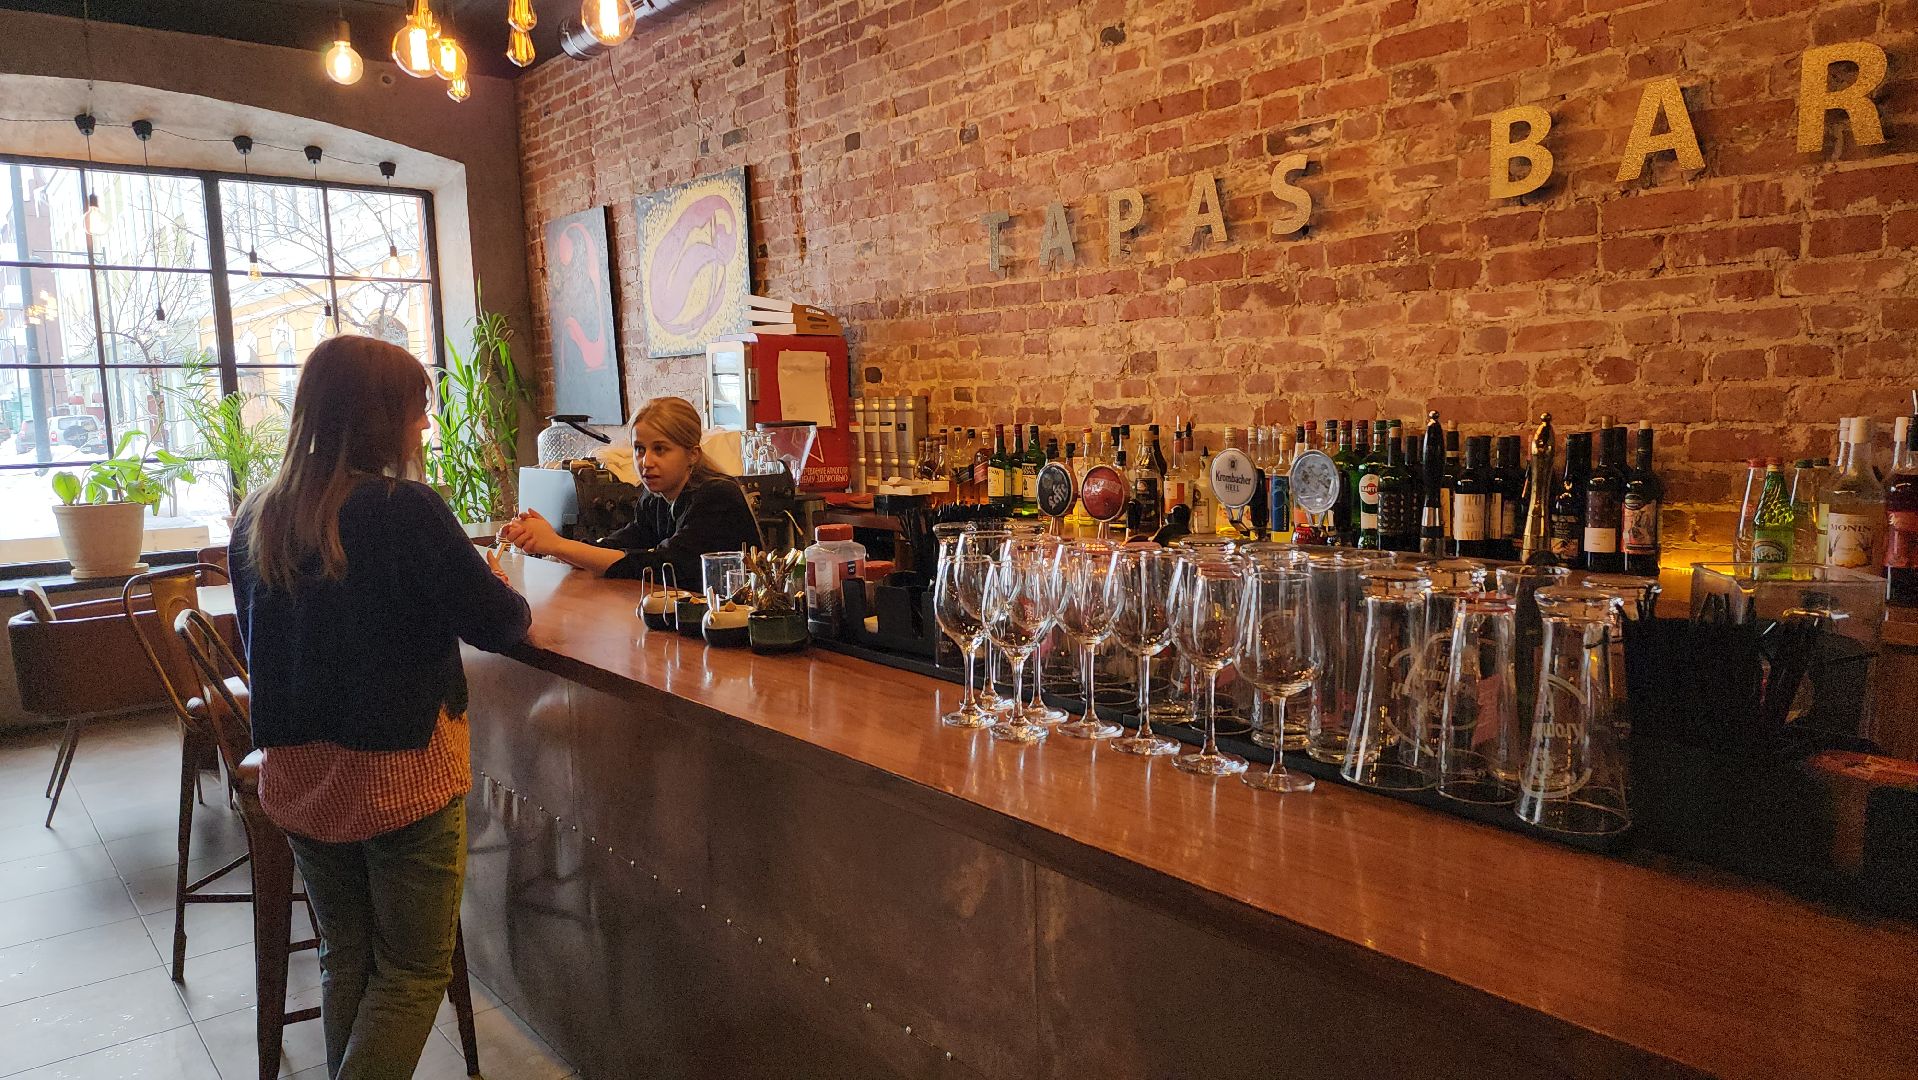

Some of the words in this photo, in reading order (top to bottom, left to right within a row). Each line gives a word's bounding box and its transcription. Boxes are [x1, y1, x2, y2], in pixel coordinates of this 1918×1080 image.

[981, 154, 1313, 272] TAPAS
[1490, 41, 1888, 200] BAR
[1215, 470, 1251, 485] Krombacher
[1225, 484, 1240, 492] HELL
[1361, 485, 1378, 493] MARTI
[1831, 523, 1872, 533] MONIN
